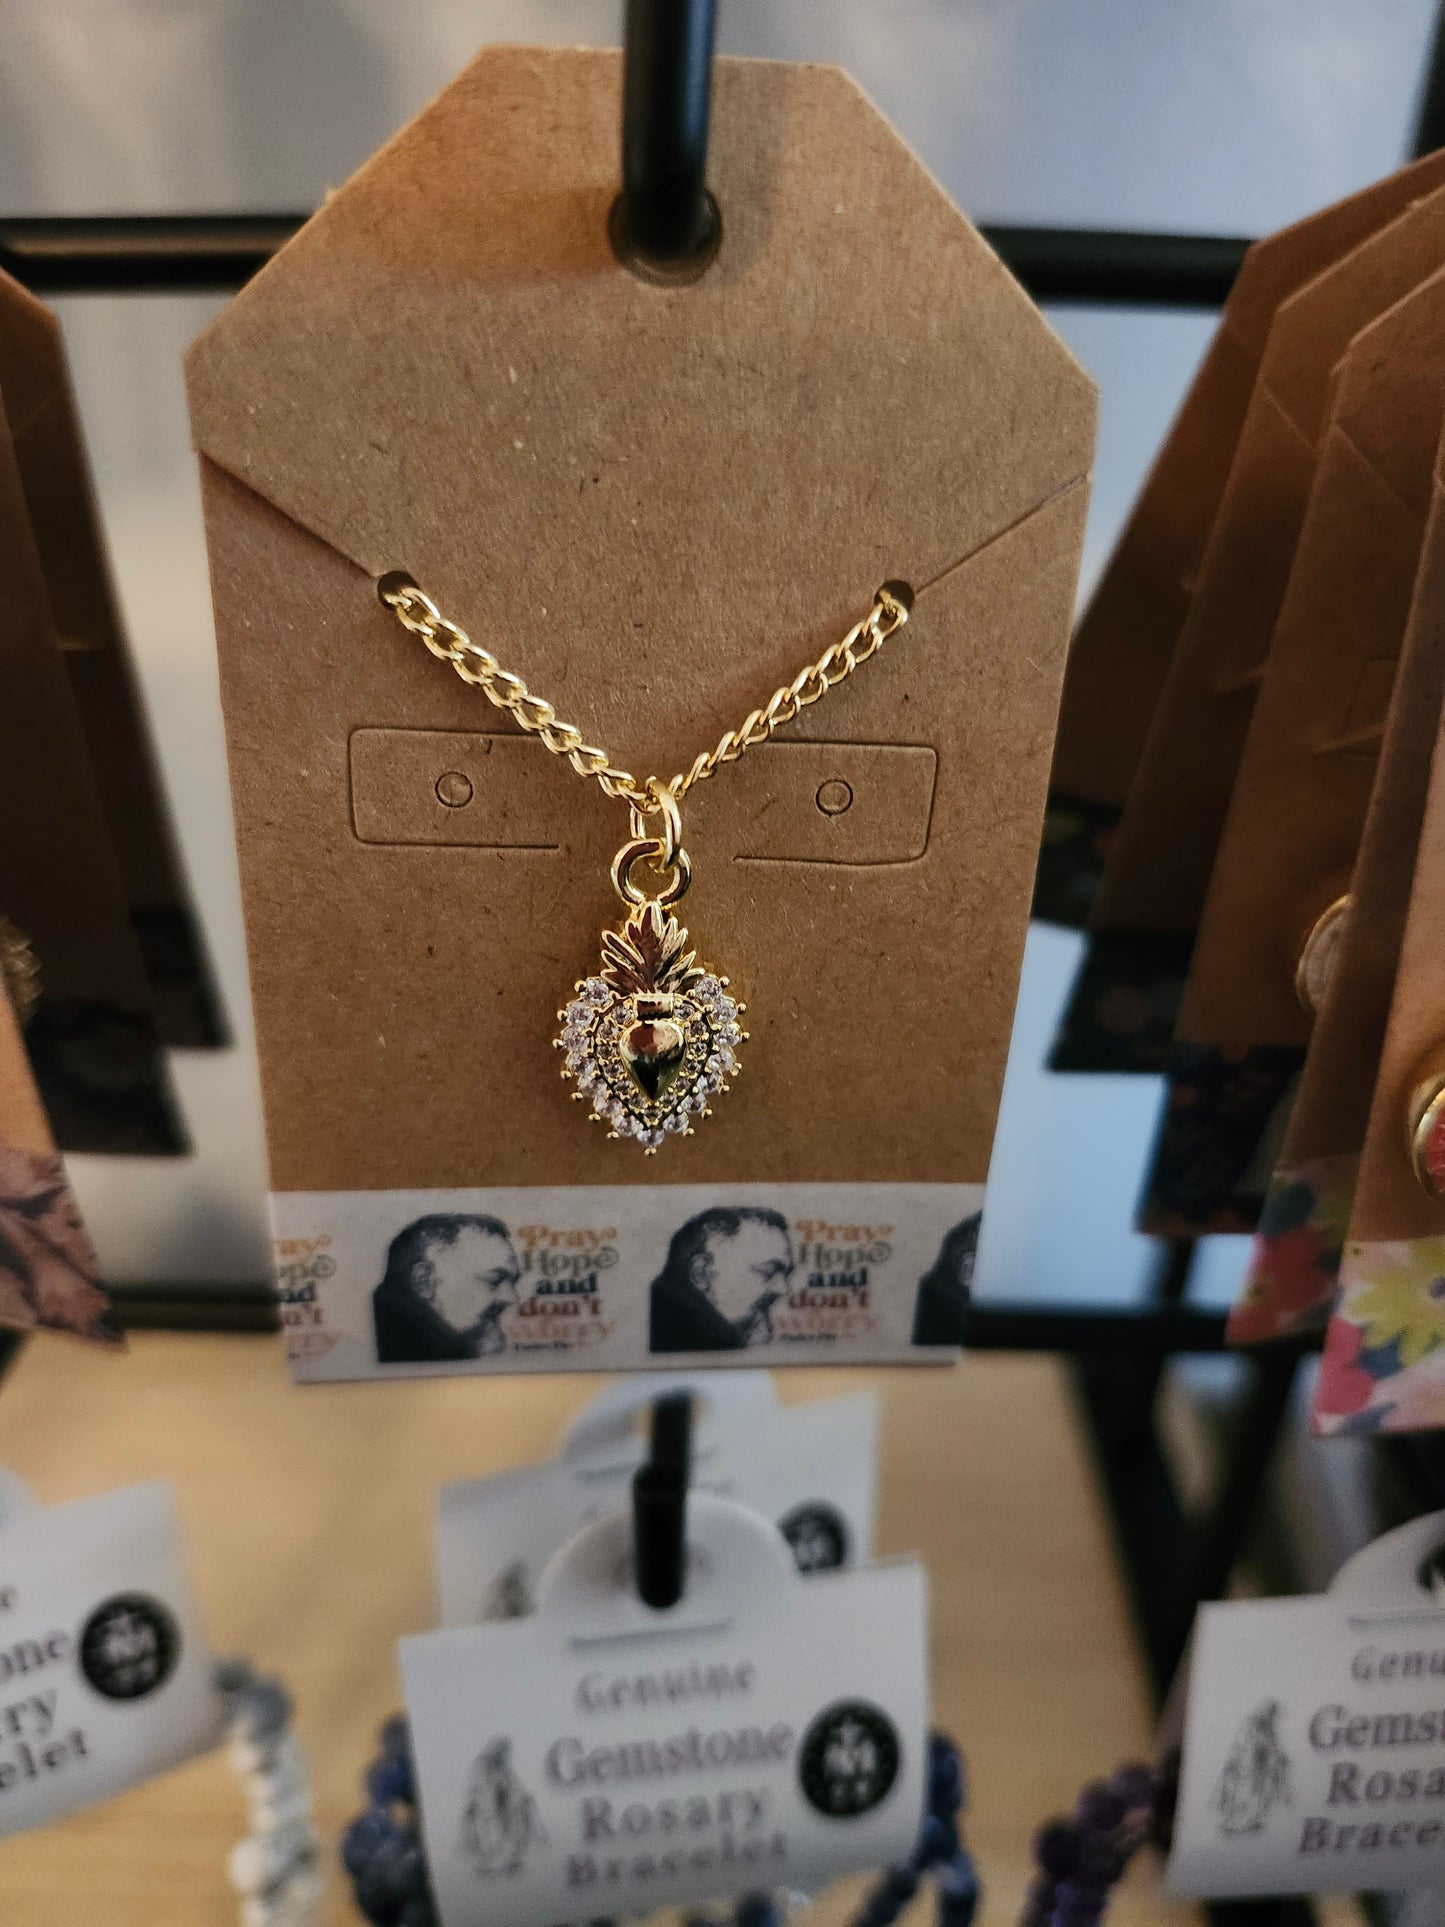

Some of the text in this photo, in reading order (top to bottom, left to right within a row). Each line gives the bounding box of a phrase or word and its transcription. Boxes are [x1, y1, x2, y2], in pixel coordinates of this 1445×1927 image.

[517, 1225, 617, 1252] Pray
[796, 1219, 894, 1244] Pray
[522, 1247, 620, 1278] Hope
[799, 1241, 893, 1271] Hope
[536, 1272, 598, 1295] and
[808, 1266, 868, 1288] and
[518, 1294, 602, 1317] don't
[788, 1287, 870, 1310] don't
[576, 1662, 755, 1712] Genuine
[544, 1721, 795, 1788] Gemstone
[581, 1786, 772, 1842] Rosary
[566, 1830, 788, 1888] Bracelet
